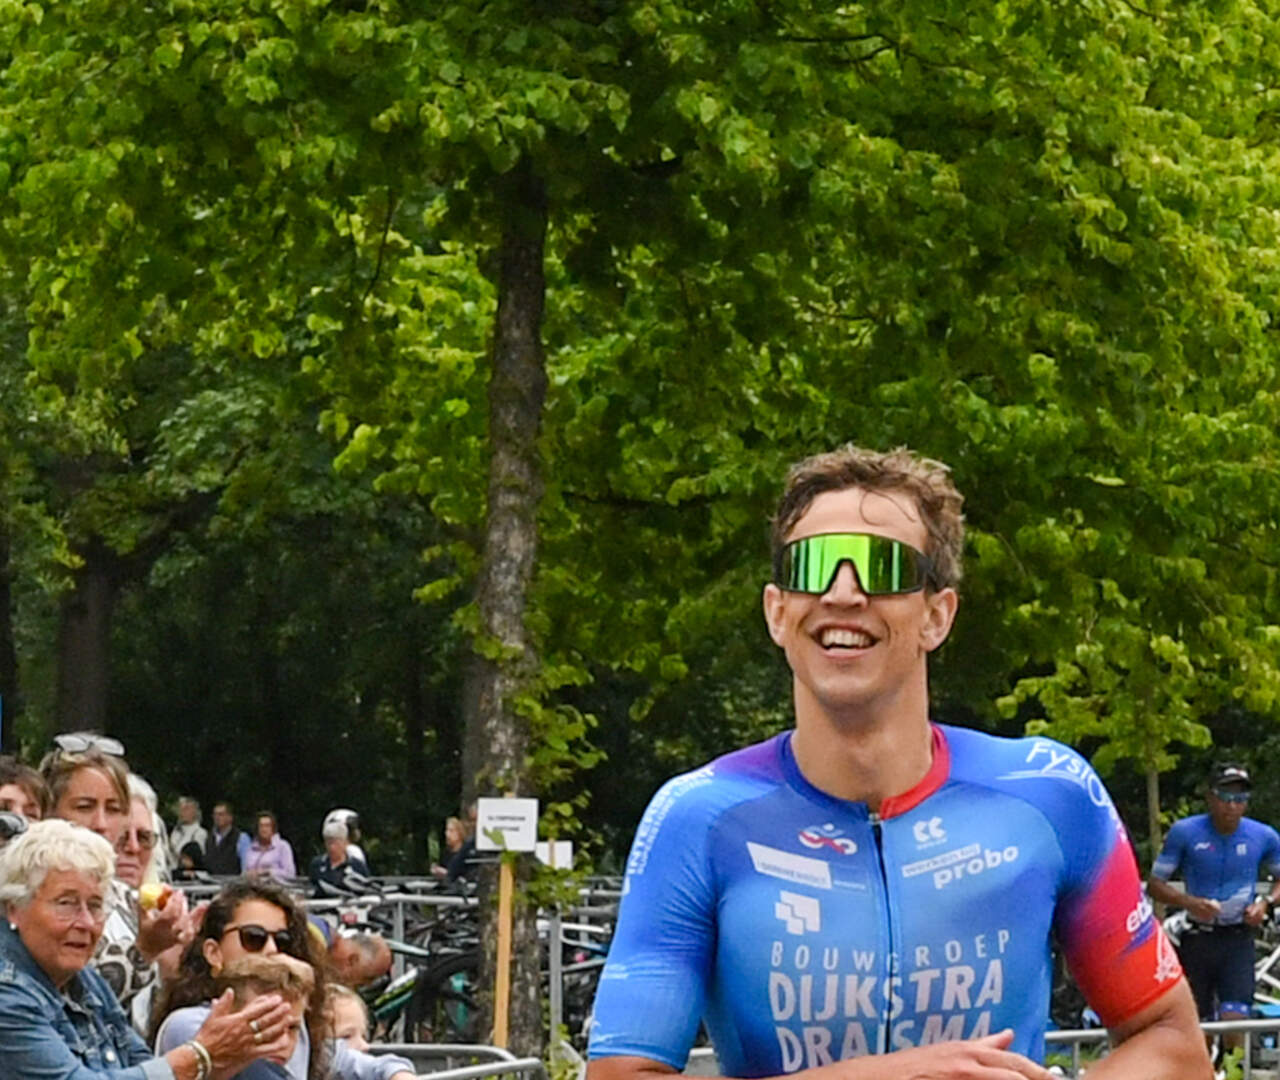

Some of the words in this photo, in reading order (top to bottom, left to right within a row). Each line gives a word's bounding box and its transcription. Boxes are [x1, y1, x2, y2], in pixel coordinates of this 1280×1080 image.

[933, 846, 1019, 890] probo
[771, 930, 1010, 973] BOUWGROEP
[769, 958, 1003, 1022] DIJKSTRA
[776, 1010, 992, 1074] DRAISMA
